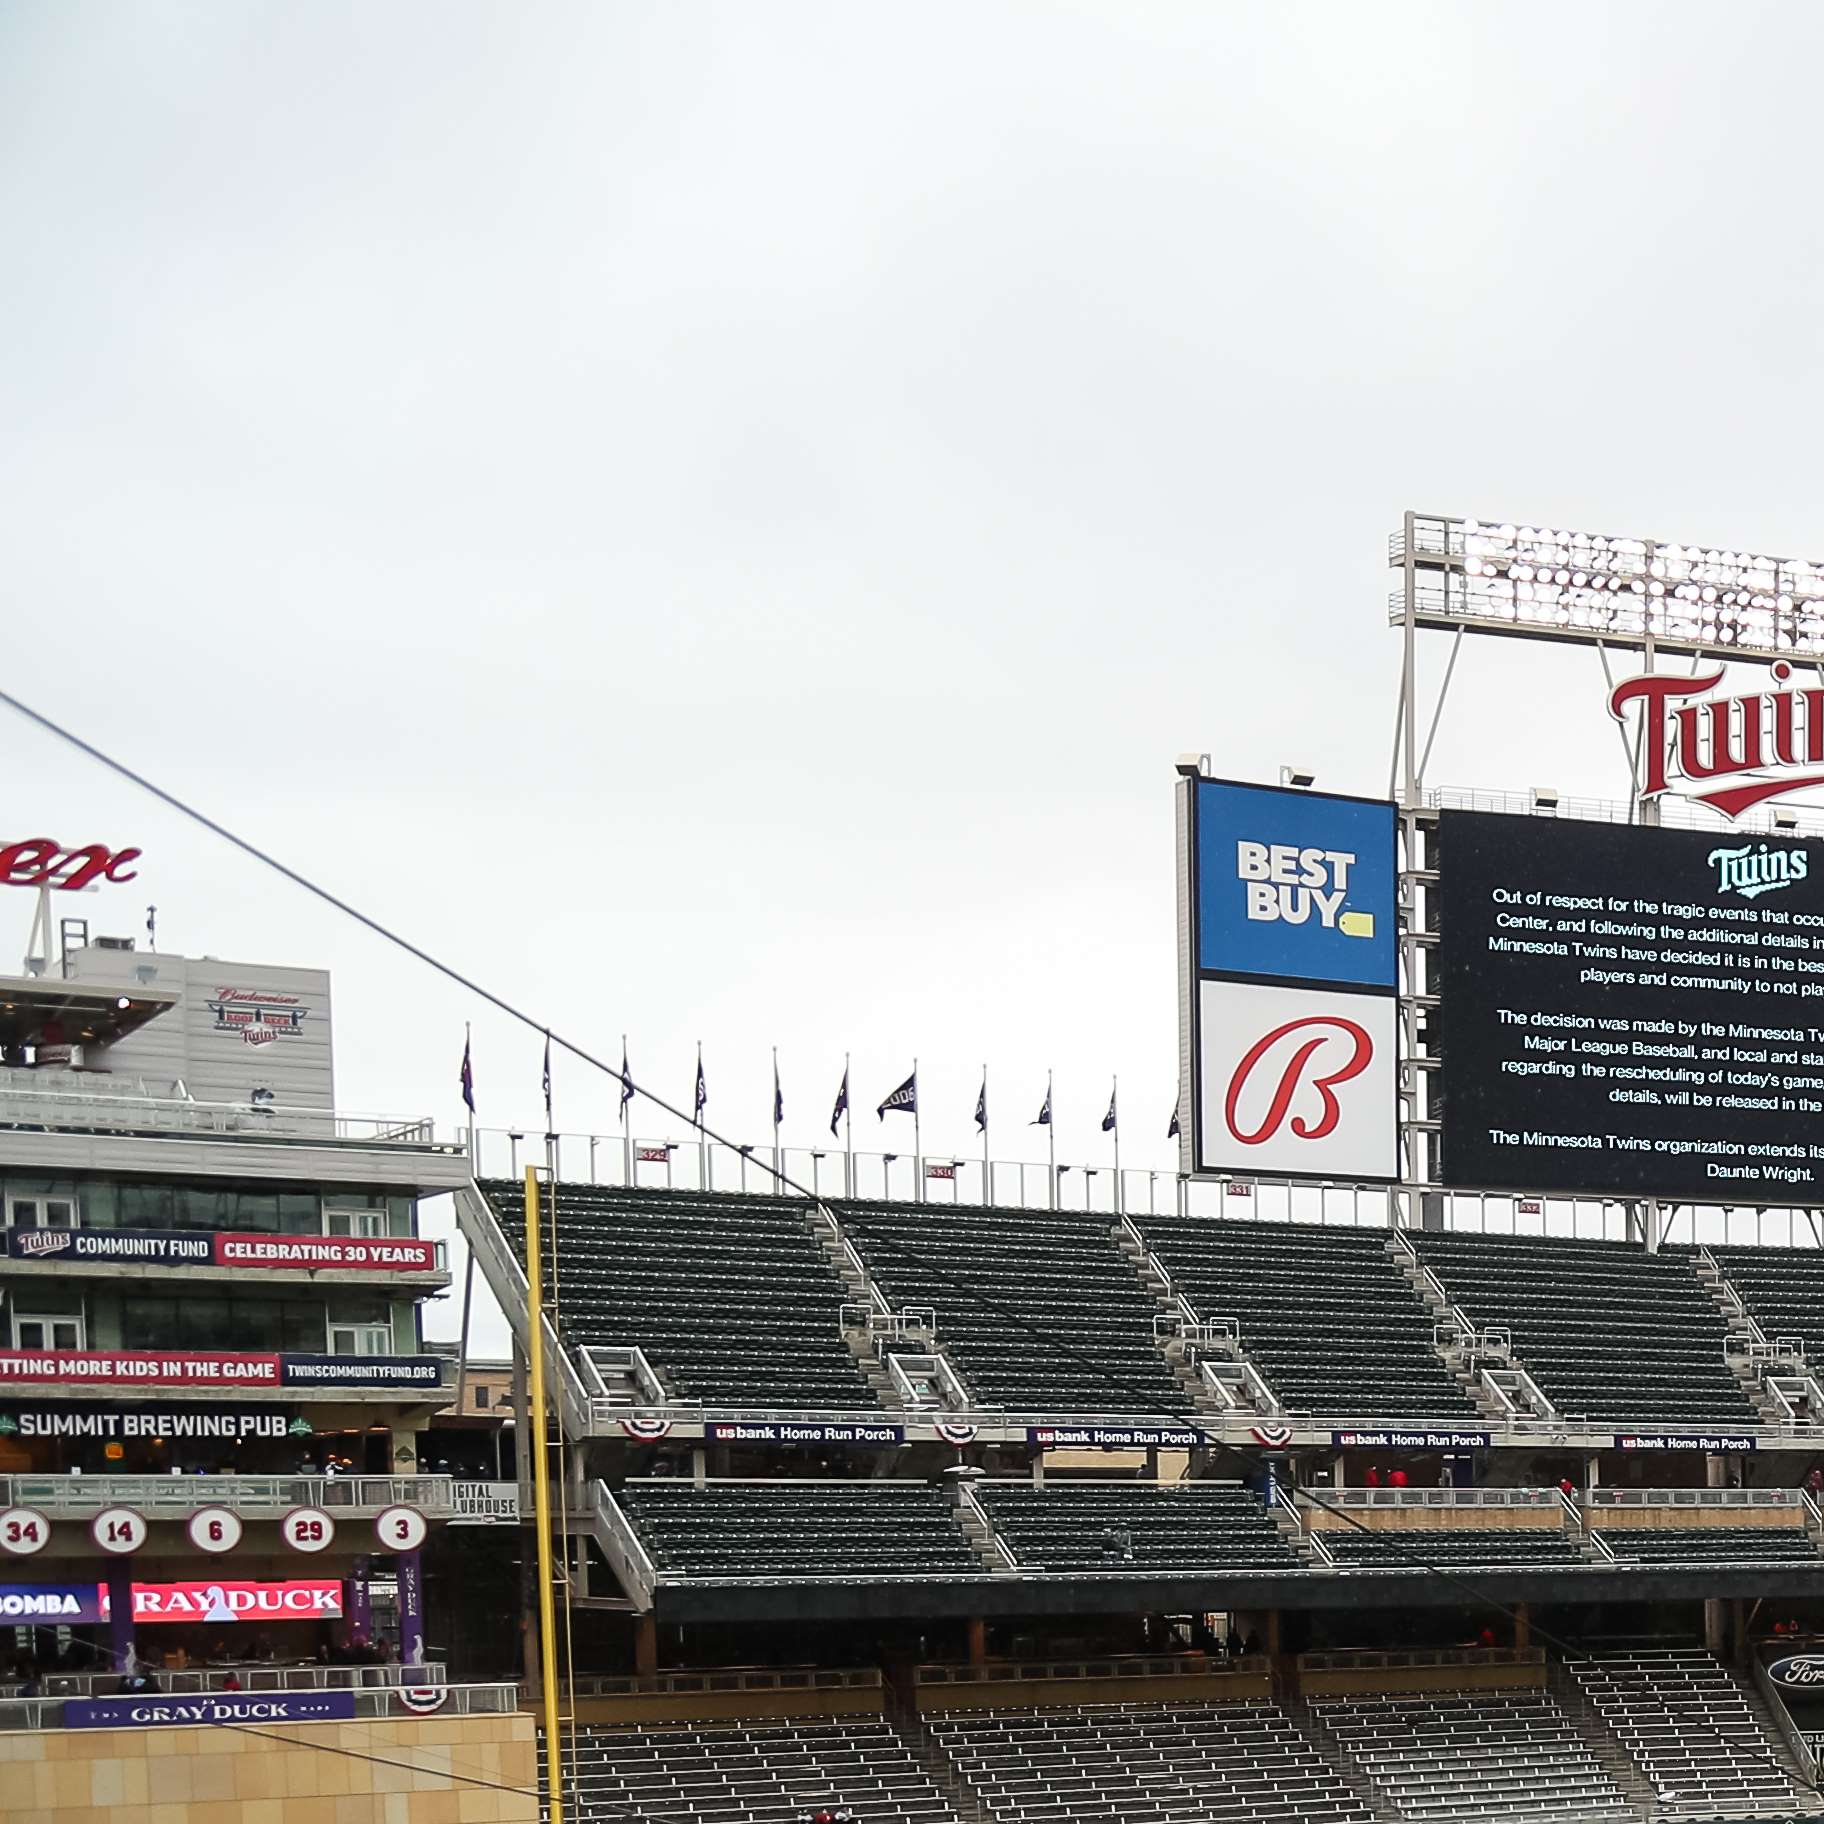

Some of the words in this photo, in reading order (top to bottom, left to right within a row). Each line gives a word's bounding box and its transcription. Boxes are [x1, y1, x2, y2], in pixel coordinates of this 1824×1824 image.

[1237, 841, 1356, 891] BEST
[1707, 843, 1808, 900] Twins
[1247, 881, 1347, 928] BUY
[1492, 888, 1522, 904] Out
[1525, 891, 1542, 906] of
[1545, 895, 1604, 911] respect
[1607, 896, 1630, 912] for
[1633, 899, 1659, 915] the
[1661, 901, 1706, 920] tragic
[1708, 907, 1759, 922] events
[1761, 909, 1790, 925] that
[1496, 912, 1553, 932] Center,
[1556, 918, 1586, 933] and
[1589, 919, 1656, 941] following
[1659, 924, 1685, 940] the
[1687, 927, 1759, 945] additional
[1761, 932, 1810, 949] details
[1488, 936, 1569, 956] Minnesota
[1571, 941, 1618, 959] Twins
[1621, 945, 1658, 962] have
[1660, 948, 1721, 966] decided
[1724, 953, 1735, 967] it
[1737, 953, 1751, 969] is
[1754, 955, 1768, 969] in
[1771, 956, 1795, 971] the
[1580, 967, 1636, 985] players
[1638, 972, 1667, 986] and
[1670, 975, 1752, 994] community
[1754, 979, 1771, 993] to
[1773, 981, 1798, 995] not
[18, 1232, 70, 1255] Twins
[76, 1237, 167, 1257] COMMUNITY
[170, 1240, 209, 1257] FUND
[224, 1242, 342, 1261] CELEBRATING
[345, 1246, 367, 1261] 30
[367, 1248, 426, 1262] YEARS
[0, 1358, 56, 1375] TTING
[59, 1359, 113, 1376] MORE
[116, 1360, 159, 1376] KIDS
[162, 1361, 182, 1377] IN
[185, 1362, 220, 1377] THE
[222, 1362, 275, 1378] GAME
[288, 1364, 436, 1379] TWINSCOMMUNITYFUND.ORG
[19, 1414, 119, 1436] SUMMIT
[123, 1415, 236, 1436] BREWING
[240, 1416, 287, 1437] PUB
[780, 1427, 821, 1440] Home
[825, 1428, 852, 1440] Run
[855, 1427, 895, 1441] Porch
[1392, 1434, 1425, 1446] Home
[1428, 1434, 1449, 1446] Run
[1451, 1434, 1484, 1446] Porch
[7, 1521, 38, 1543] 34
[107, 1521, 133, 1543] 14
[208, 1520, 224, 1542] 6
[295, 1520, 323, 1542] 29
[395, 1519, 409, 1540] 3
[134, 1592, 209, 1614] RAY
[228, 1587, 340, 1612] DUCK
[131, 1705, 209, 1722] GRAY
[214, 1703, 288, 1719] DUCK
